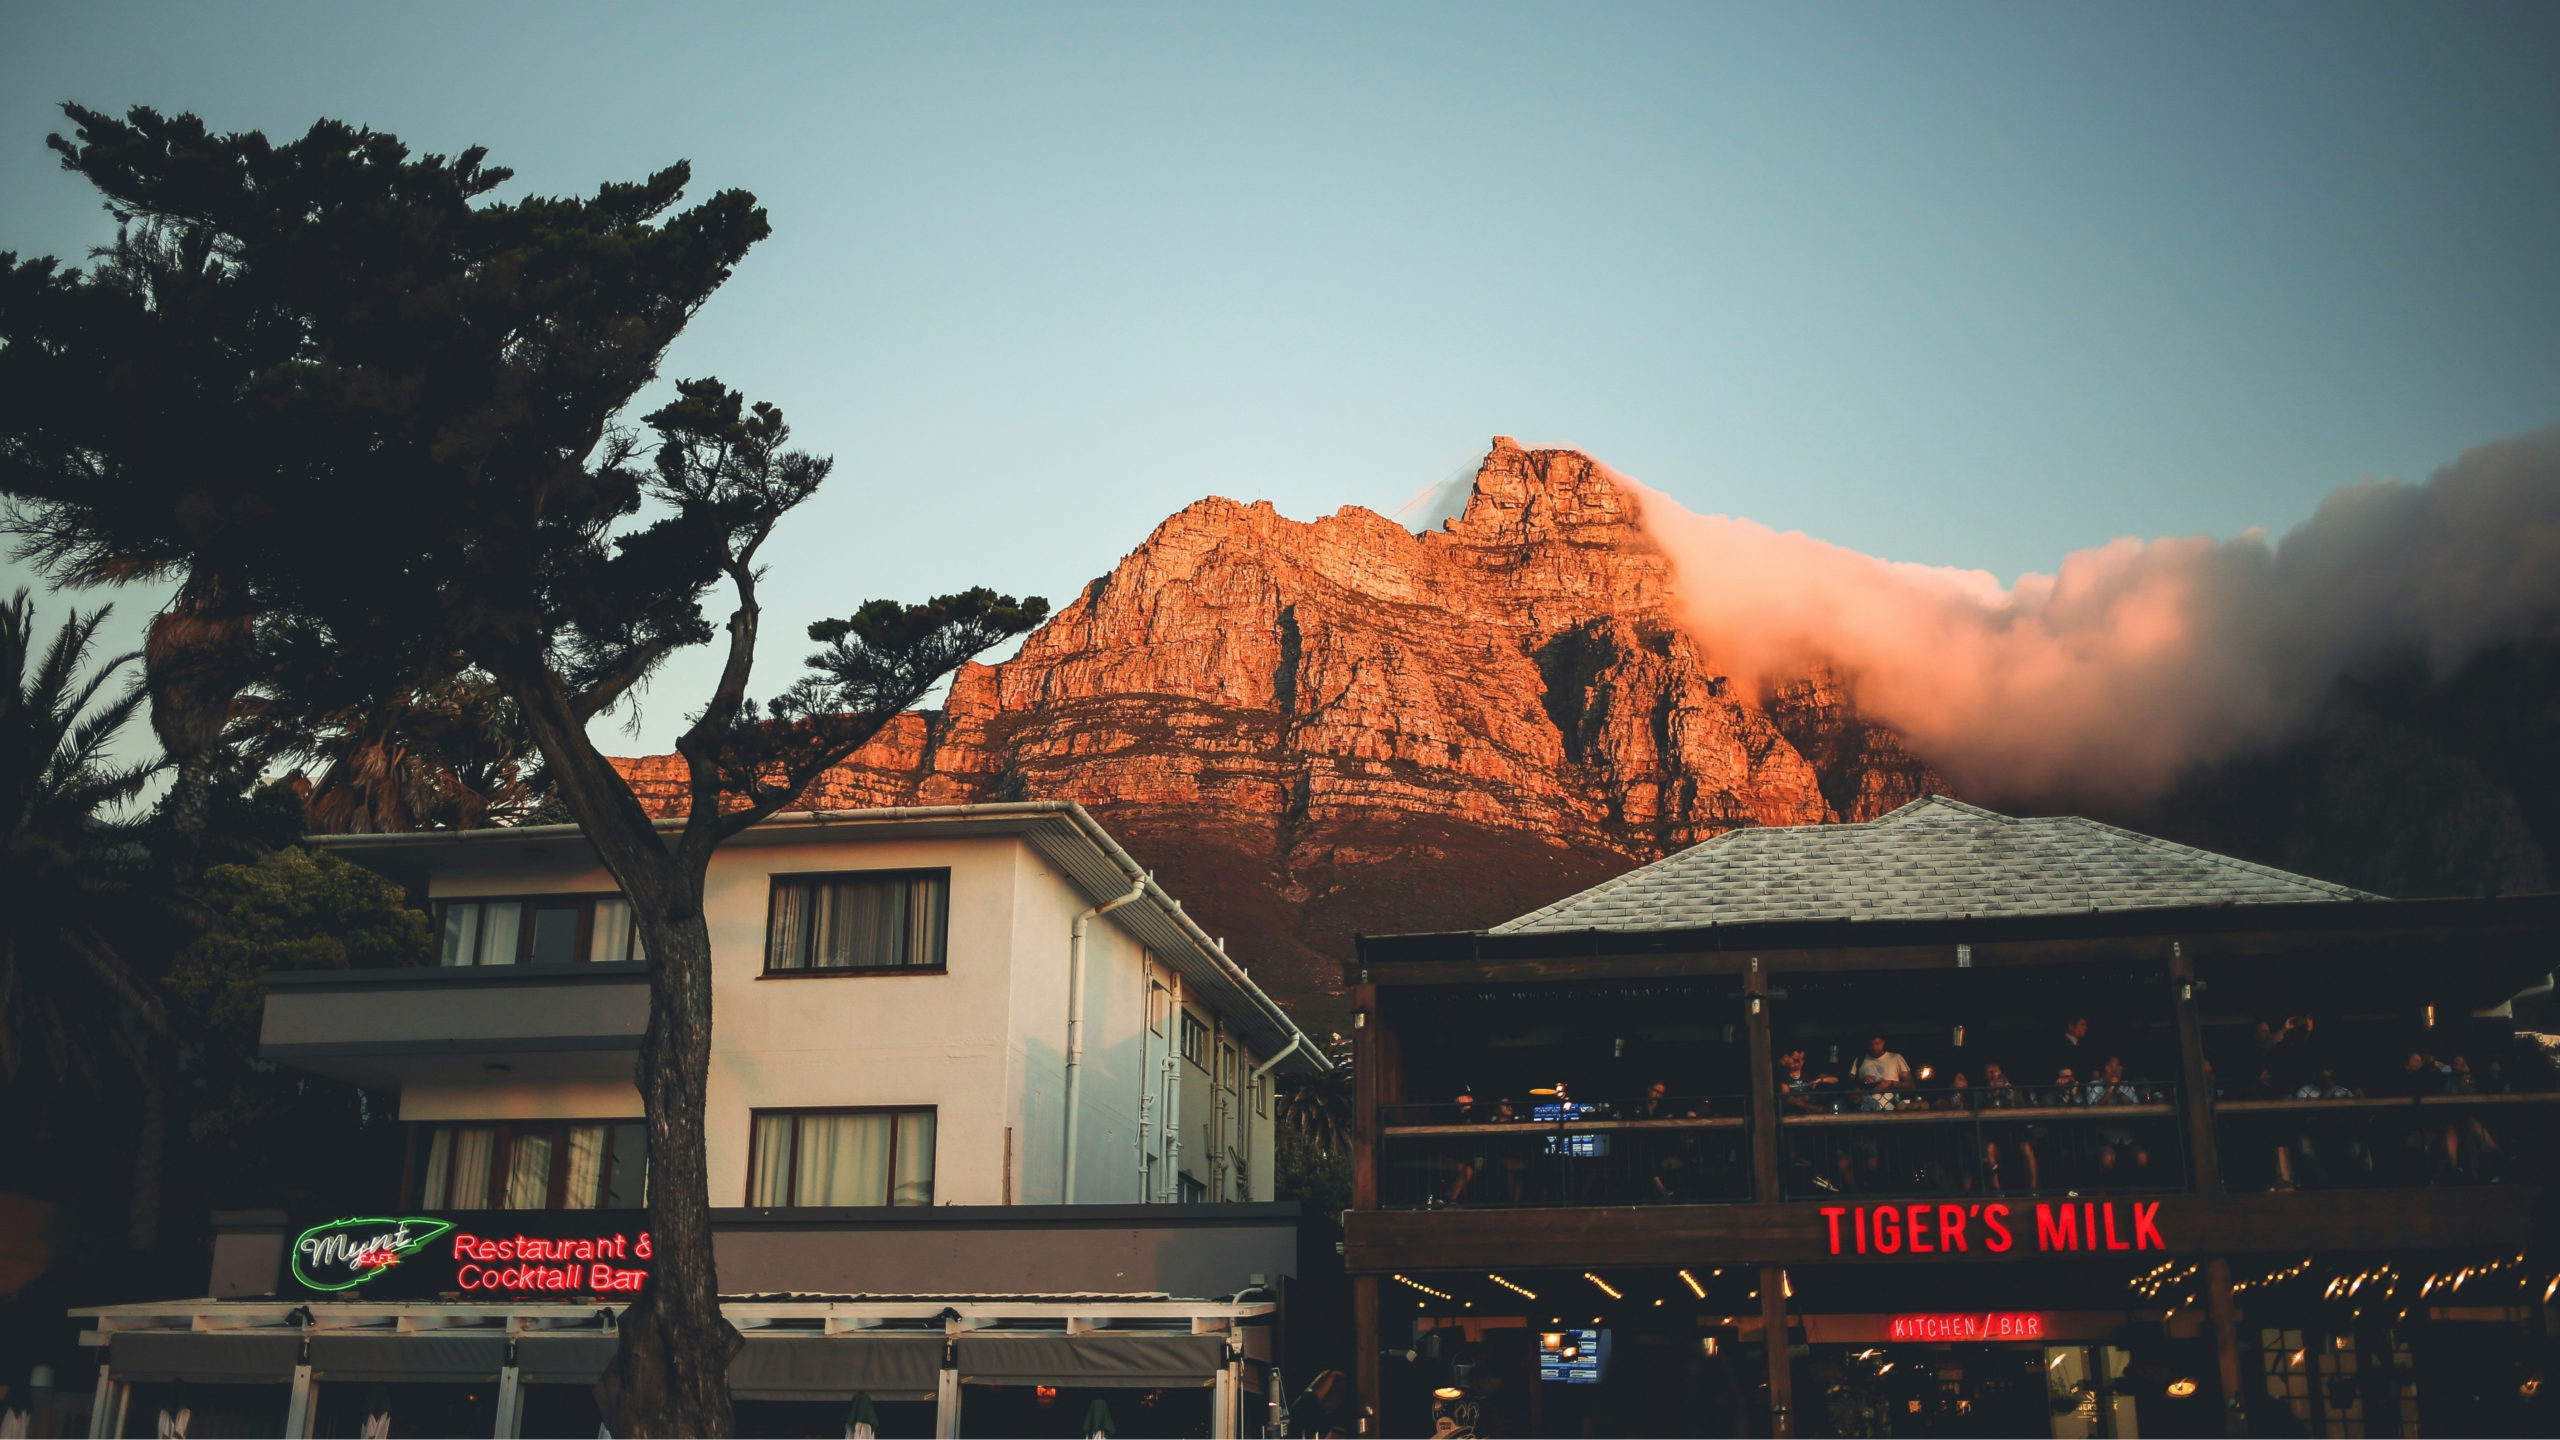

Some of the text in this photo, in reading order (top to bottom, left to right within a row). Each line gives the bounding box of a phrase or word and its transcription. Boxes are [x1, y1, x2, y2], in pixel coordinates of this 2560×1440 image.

[1820, 1202, 2167, 1255] TIGER'S MILK
[300, 1222, 412, 1271] Mynt
[453, 1232, 652, 1260] Restaurant &
[458, 1263, 649, 1291] Cocktail Bar
[1895, 1317, 1975, 1338] KITCHEN
[2000, 1317, 2039, 1336] BAR
